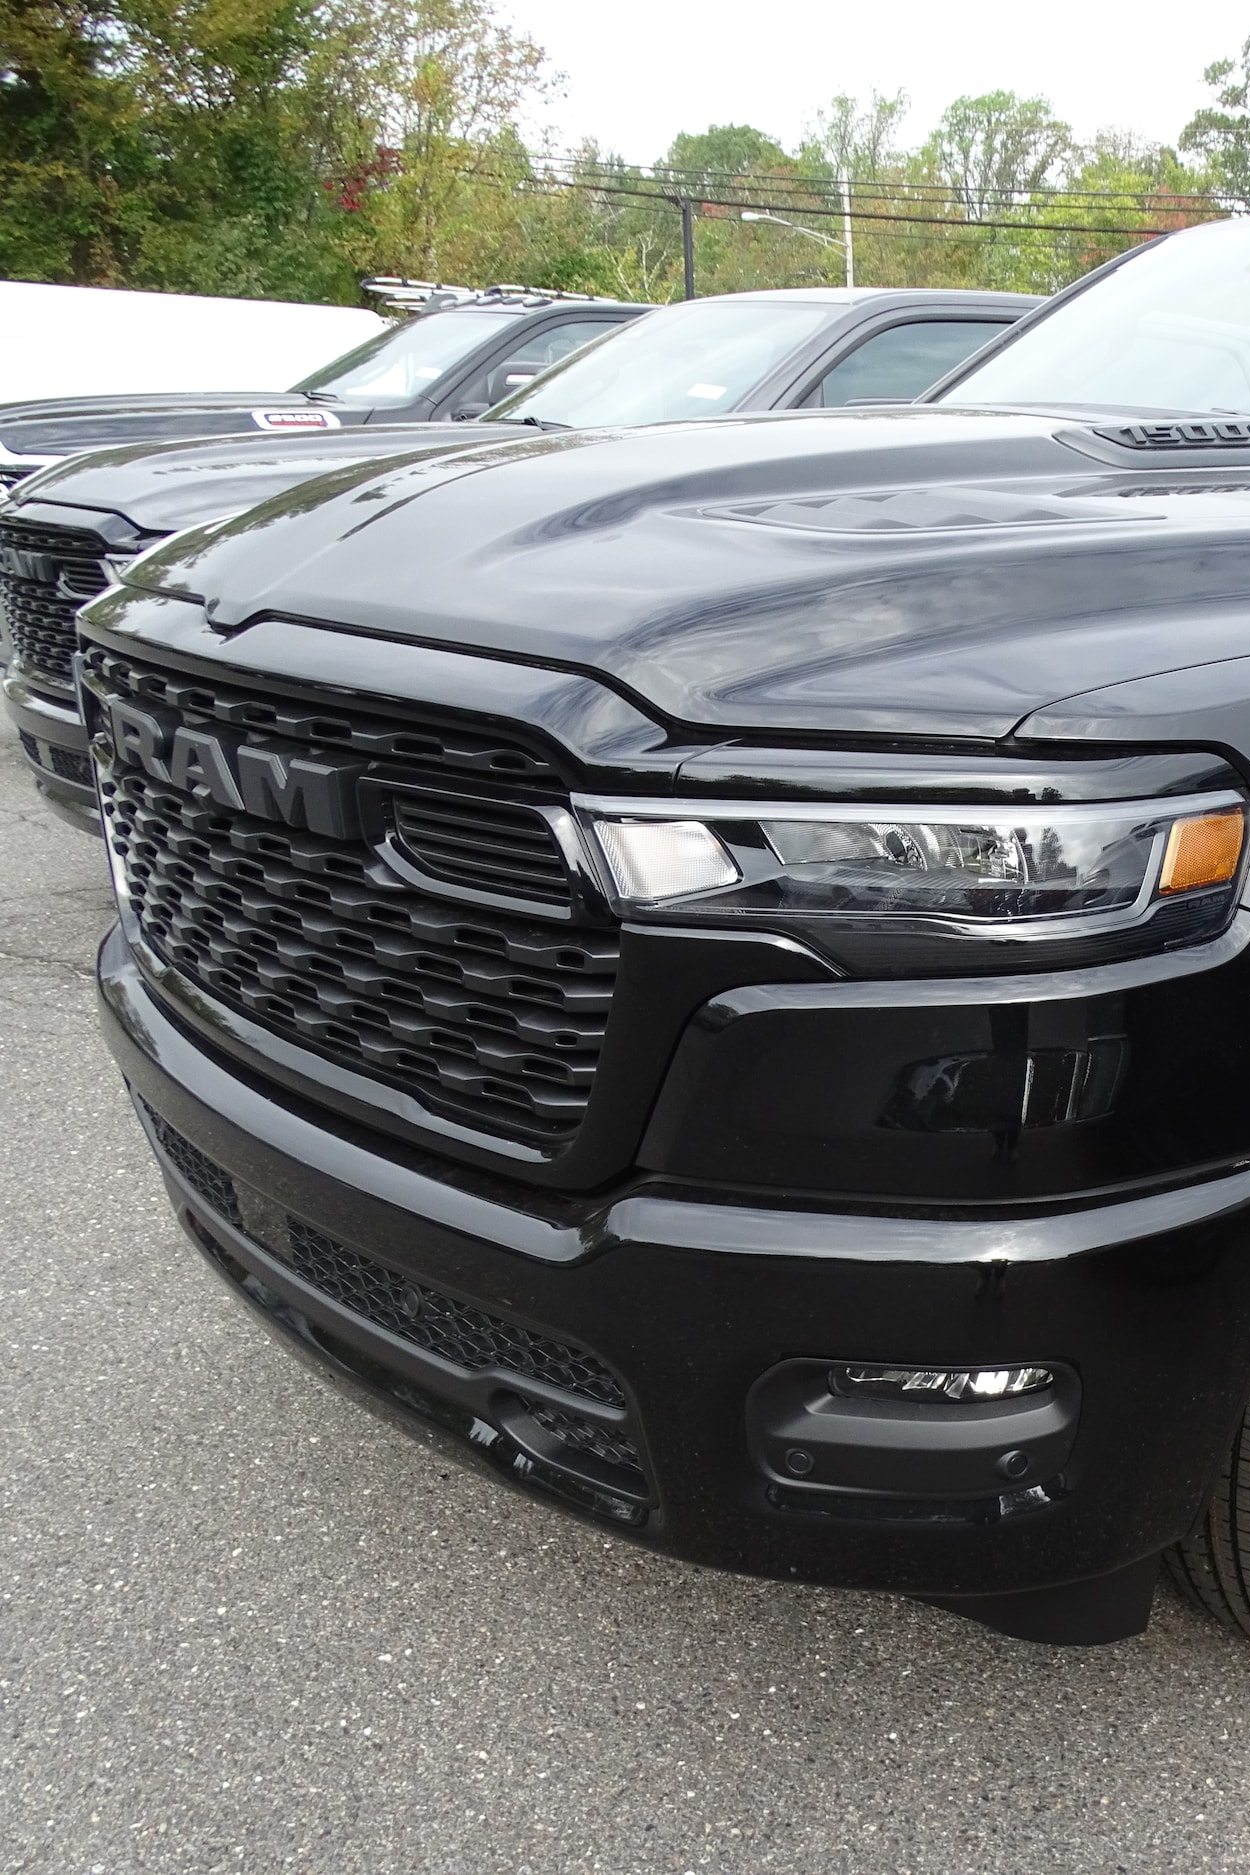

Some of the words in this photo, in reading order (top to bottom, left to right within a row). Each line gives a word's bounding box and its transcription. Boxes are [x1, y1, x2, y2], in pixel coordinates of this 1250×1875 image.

[1120, 424, 1250, 444] 1500
[0, 546, 60, 583] AM
[110, 697, 352, 840] RAM
